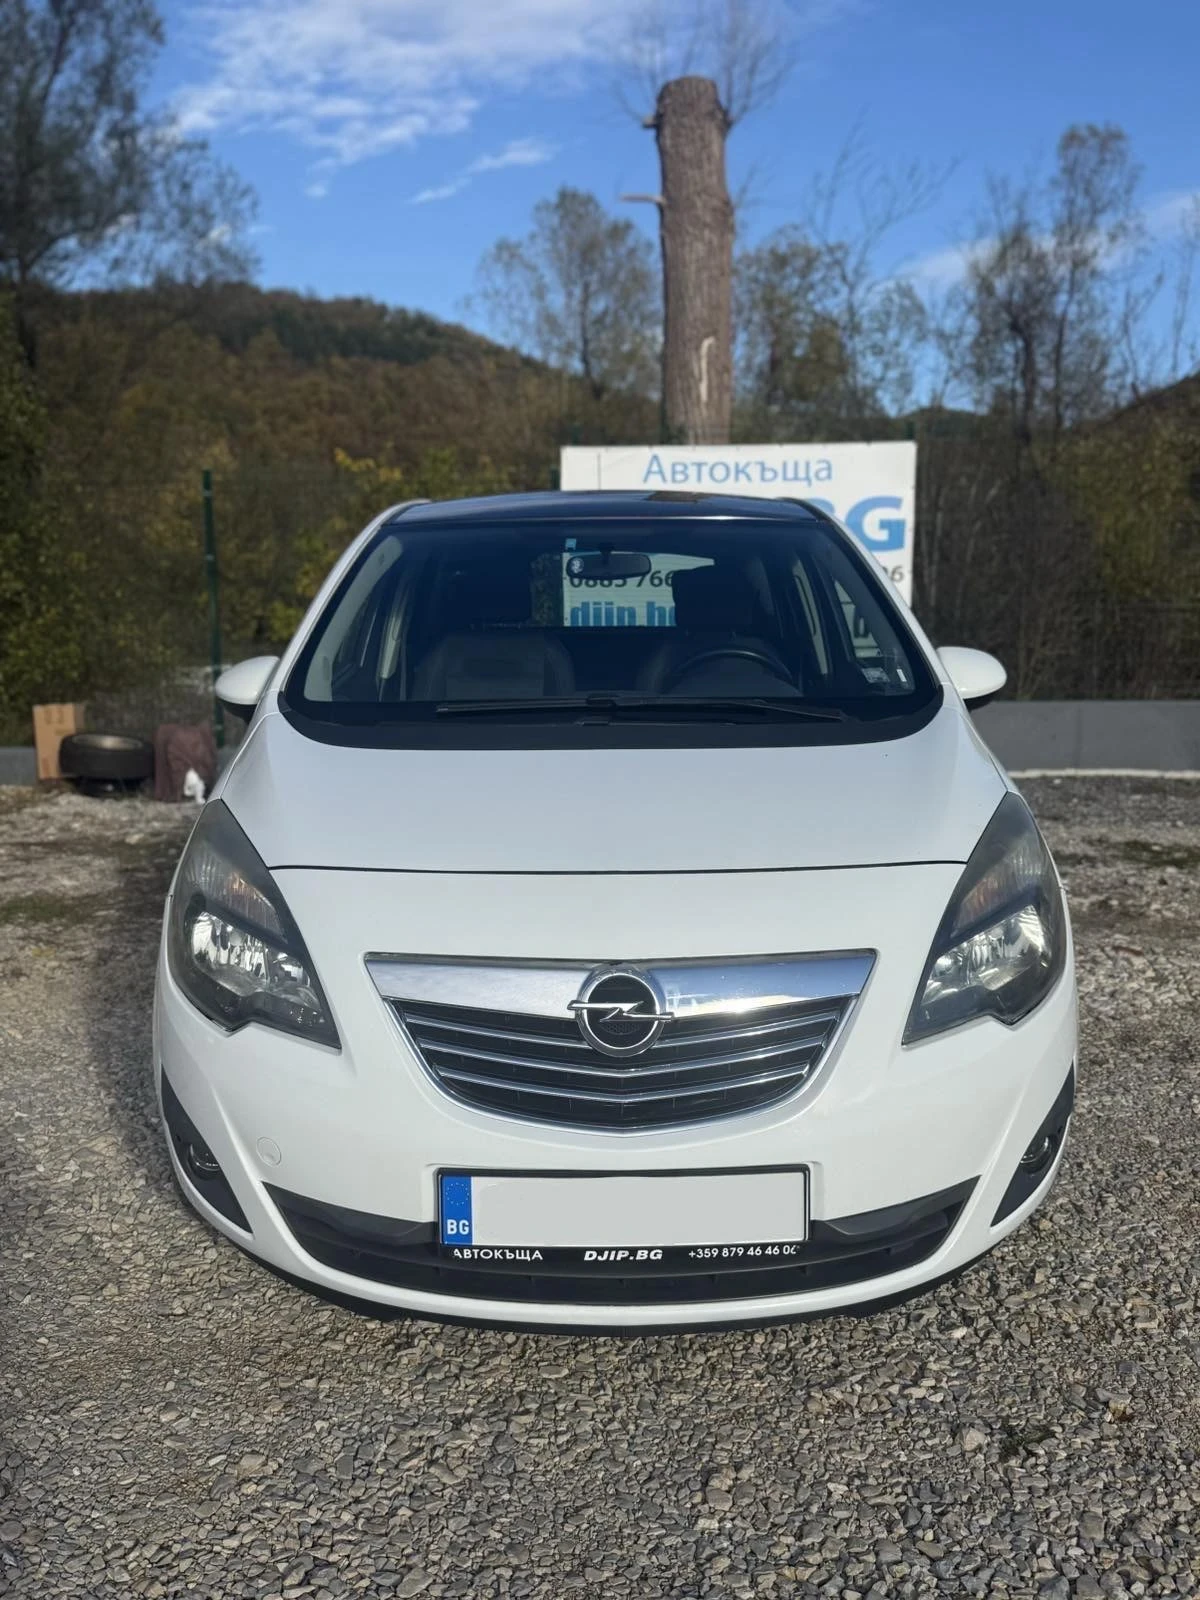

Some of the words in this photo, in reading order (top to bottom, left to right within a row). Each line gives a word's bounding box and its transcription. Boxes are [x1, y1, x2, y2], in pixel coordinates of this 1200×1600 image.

[643, 454, 833, 487] Автокъща
[446, 1219, 469, 1236] BG
[453, 1247, 543, 1262] АВТОКЪЩА
[583, 1248, 663, 1262] DJIP.BG
[688, 1247, 719, 1259] +359
[721, 1246, 744, 1258] 879
[747, 1245, 762, 1256] 46
[764, 1244, 780, 1255] 46
